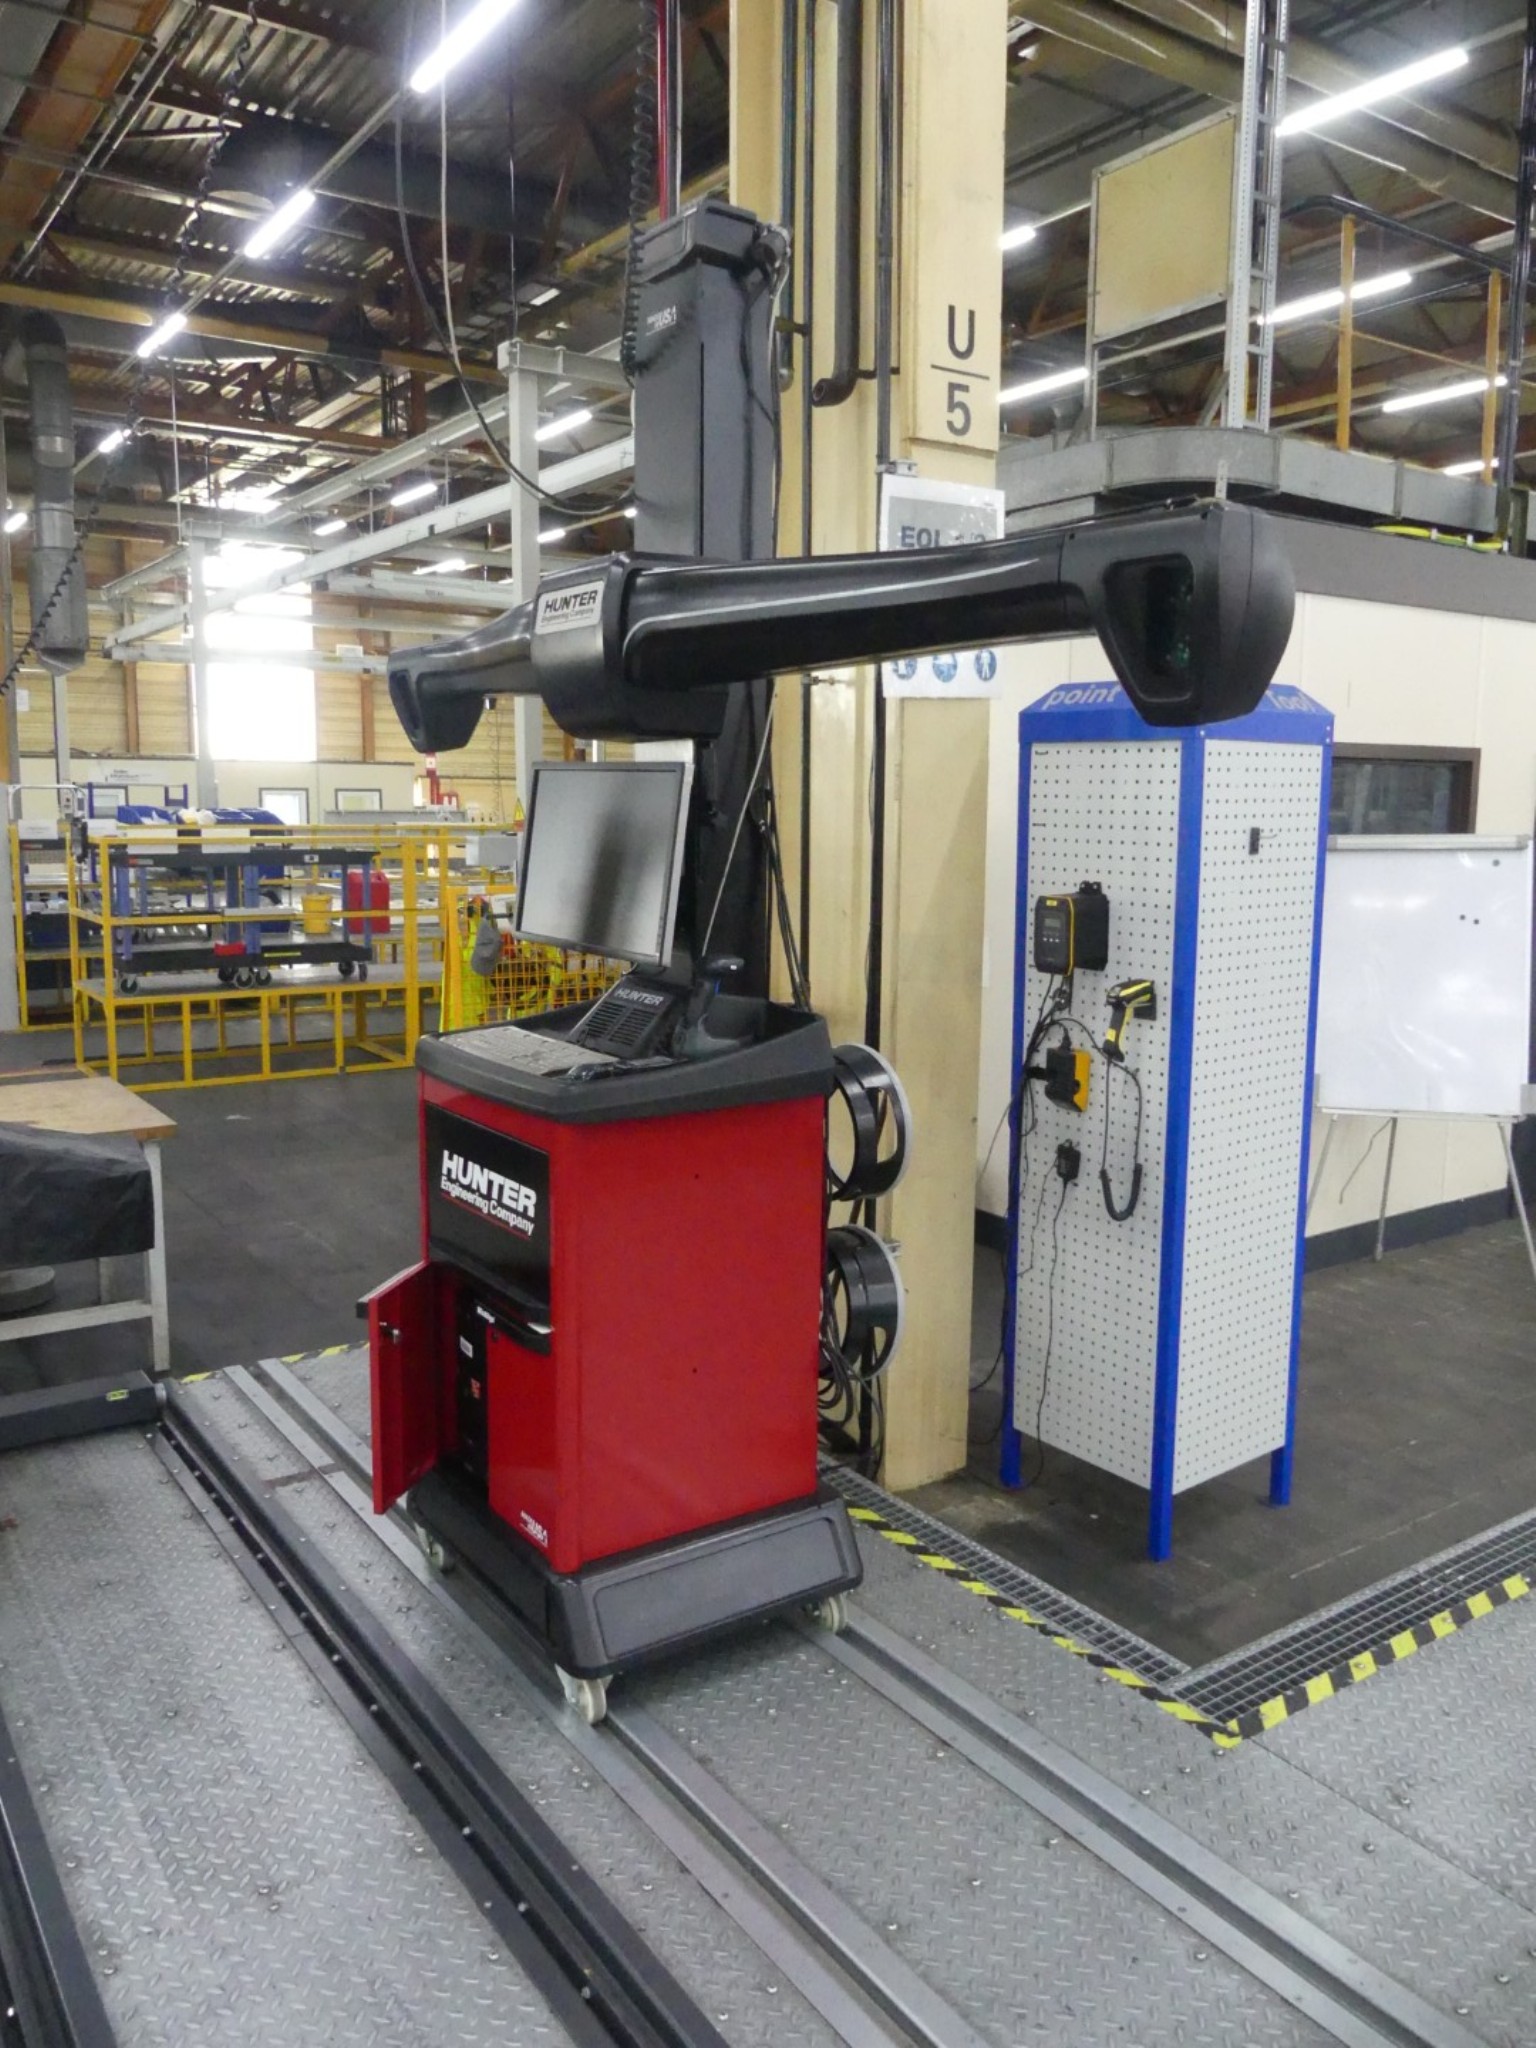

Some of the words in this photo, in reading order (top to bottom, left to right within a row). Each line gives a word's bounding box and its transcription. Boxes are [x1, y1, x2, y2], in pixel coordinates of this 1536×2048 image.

[948, 304, 975, 360] U
[946, 382, 971, 436] 5
[544, 590, 598, 614] HUNTER
[613, 988, 664, 1006] HUNTER
[440, 1176, 489, 1214] Engineering
[489, 1200, 535, 1237] Company
[442, 1149, 537, 1218] HUNTER
